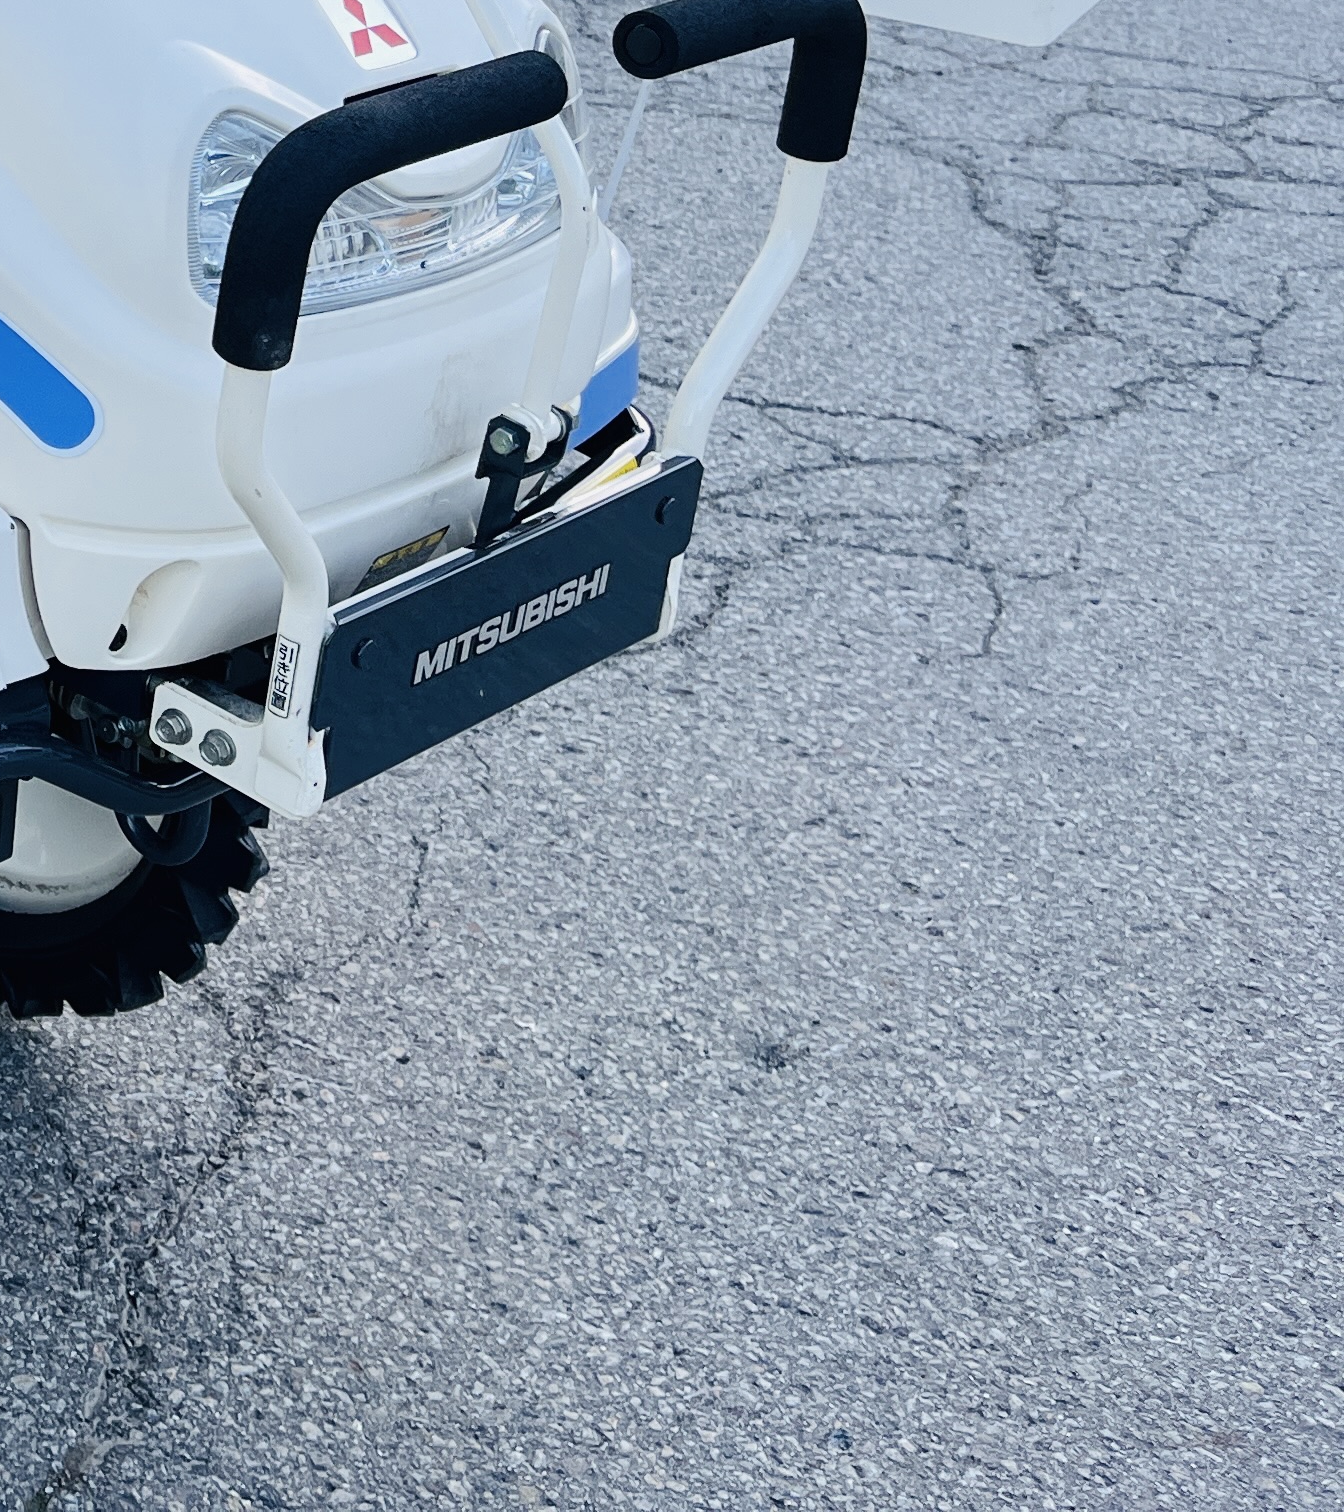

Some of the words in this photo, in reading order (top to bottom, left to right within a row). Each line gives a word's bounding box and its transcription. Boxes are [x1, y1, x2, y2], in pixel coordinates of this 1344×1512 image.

[413, 563, 610, 685] MITSUBISHI
[271, 643, 294, 711] 引き位置
